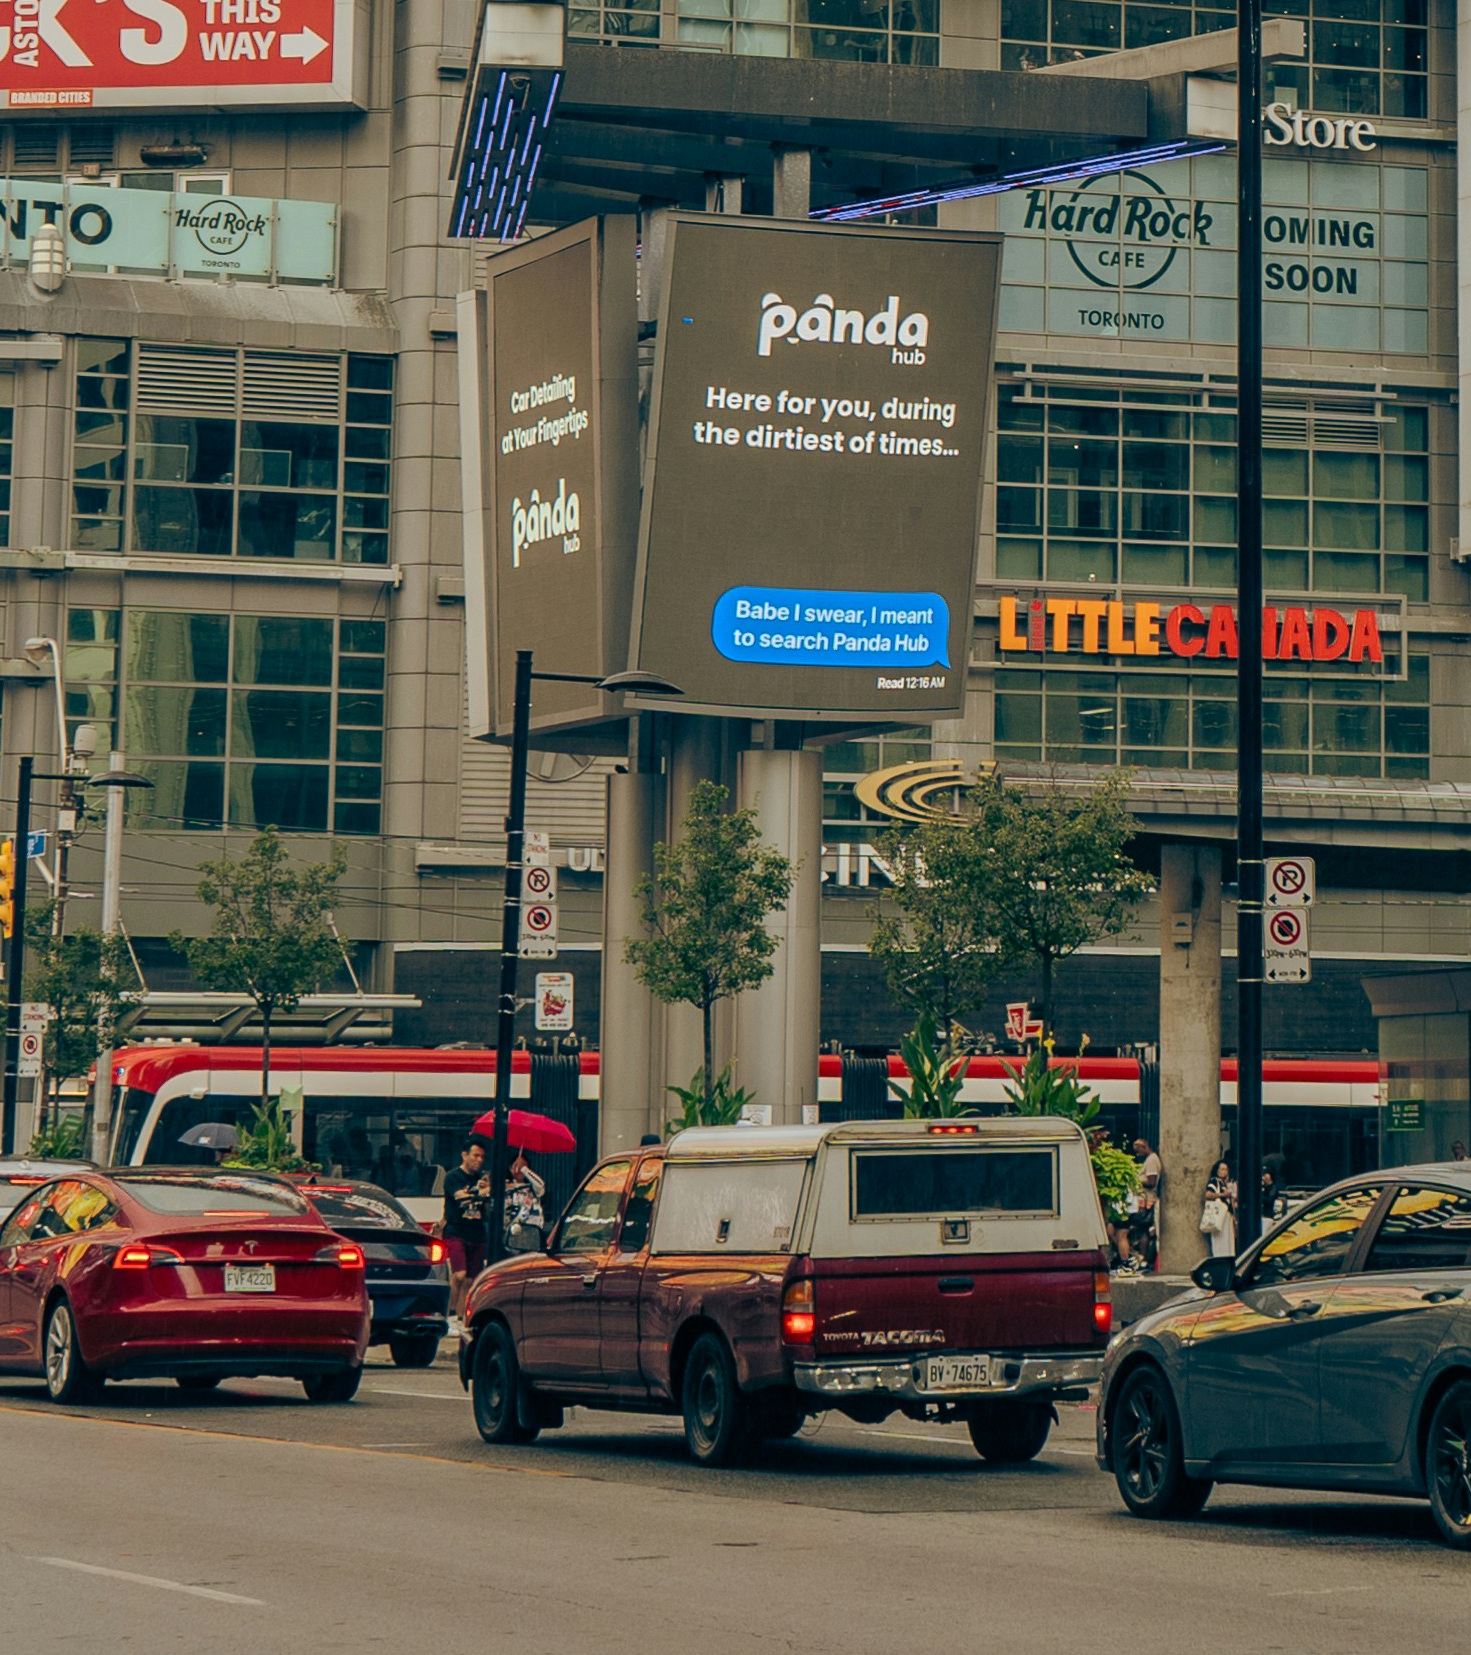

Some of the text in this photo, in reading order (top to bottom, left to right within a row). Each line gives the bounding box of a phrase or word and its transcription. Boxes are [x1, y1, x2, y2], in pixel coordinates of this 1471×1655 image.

[200, 30, 278, 63] WAY
[1264, 102, 1377, 151] Store
[174, 208, 267, 237] Hard Rock
[1023, 188, 1213, 246] Hard Rock
[1263, 215, 1375, 249] OMING
[210, 235, 233, 246] CAFE
[1098, 249, 1145, 270] CAFE
[1264, 262, 1358, 295] SOON
[758, 293, 929, 357] panda
[1077, 309, 1165, 330] TORONTO
[891, 348, 926, 366] hub
[511, 373, 576, 415] Car Detailing
[706, 386, 957, 428] Here for you, during
[501, 407, 589, 455] at Your Fingertips
[694, 421, 960, 457] the dirtiest of times...
[512, 478, 581, 568] panda
[563, 534, 581, 554] hub
[735, 601, 933, 627] Babe I swear, I meant
[733, 630, 930, 652] to search Panda Hub
[877, 676, 946, 690] Read 12:16 AM
[822, 1332, 860, 1342] TOYOTA
[930, 1364, 987, 1382] BV 74675
